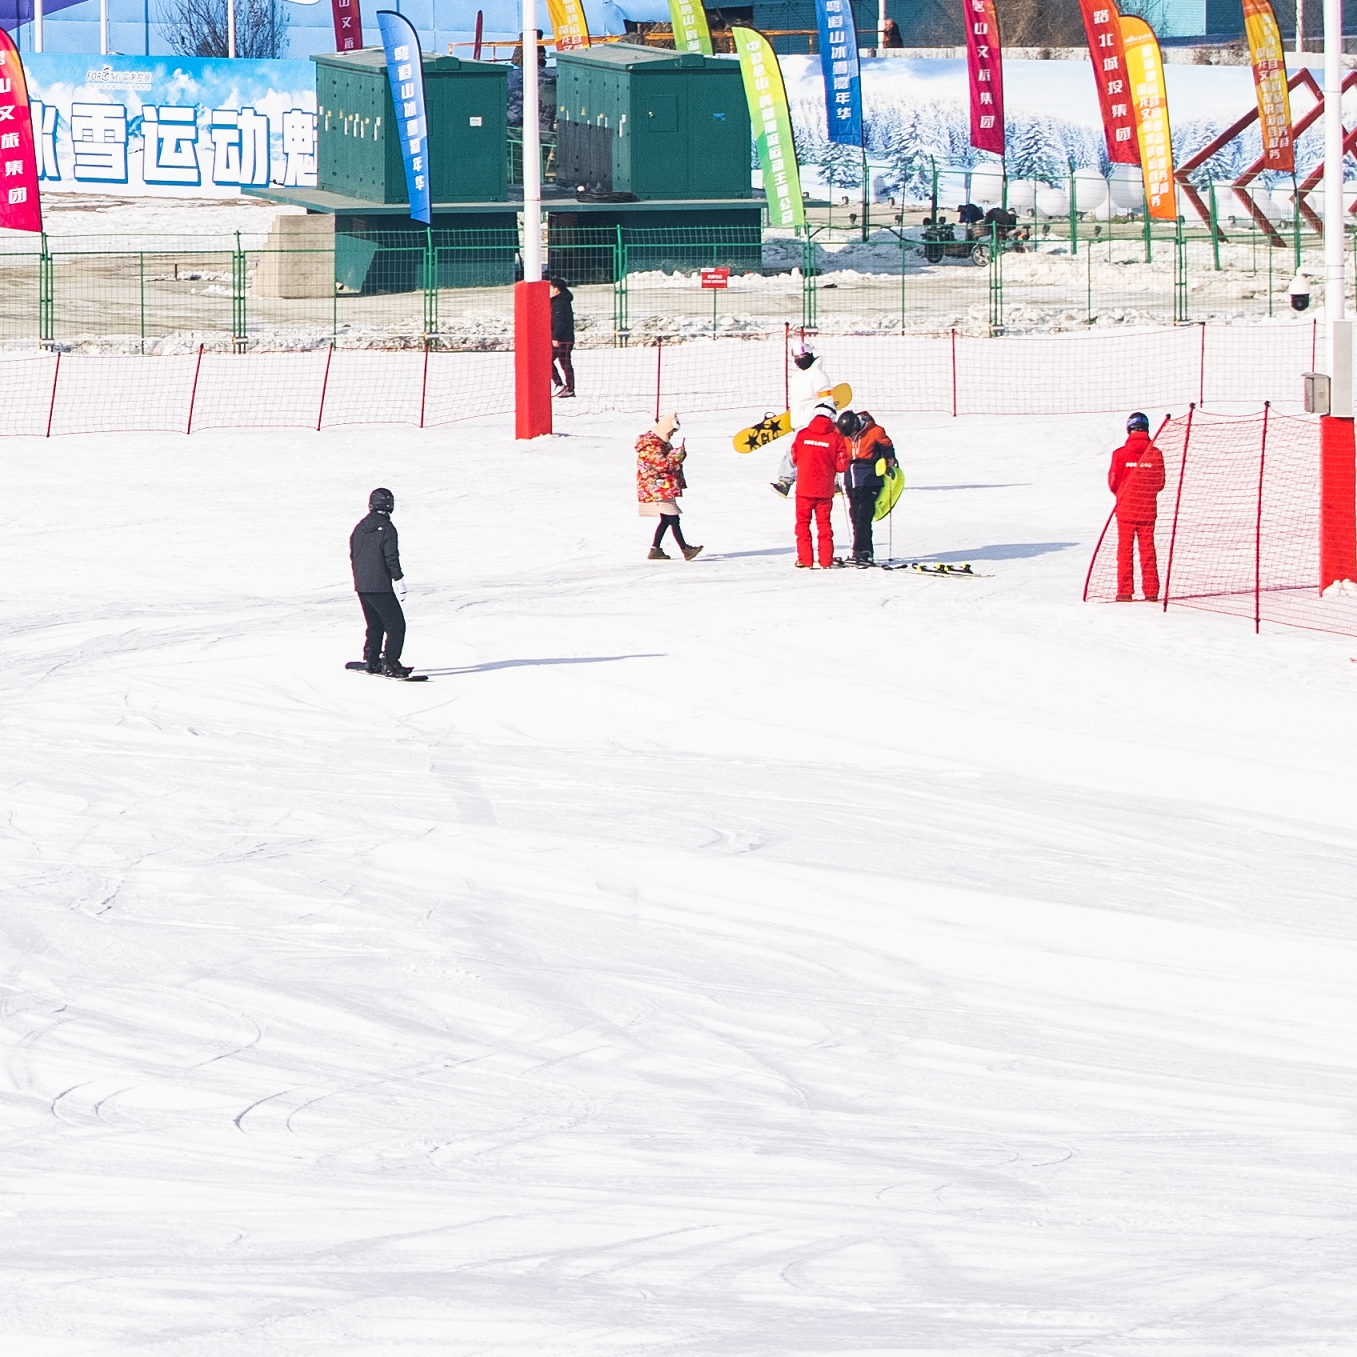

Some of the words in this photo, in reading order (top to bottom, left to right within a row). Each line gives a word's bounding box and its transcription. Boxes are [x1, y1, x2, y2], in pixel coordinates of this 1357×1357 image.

[1093, 9, 1131, 142] 路北城投集团
